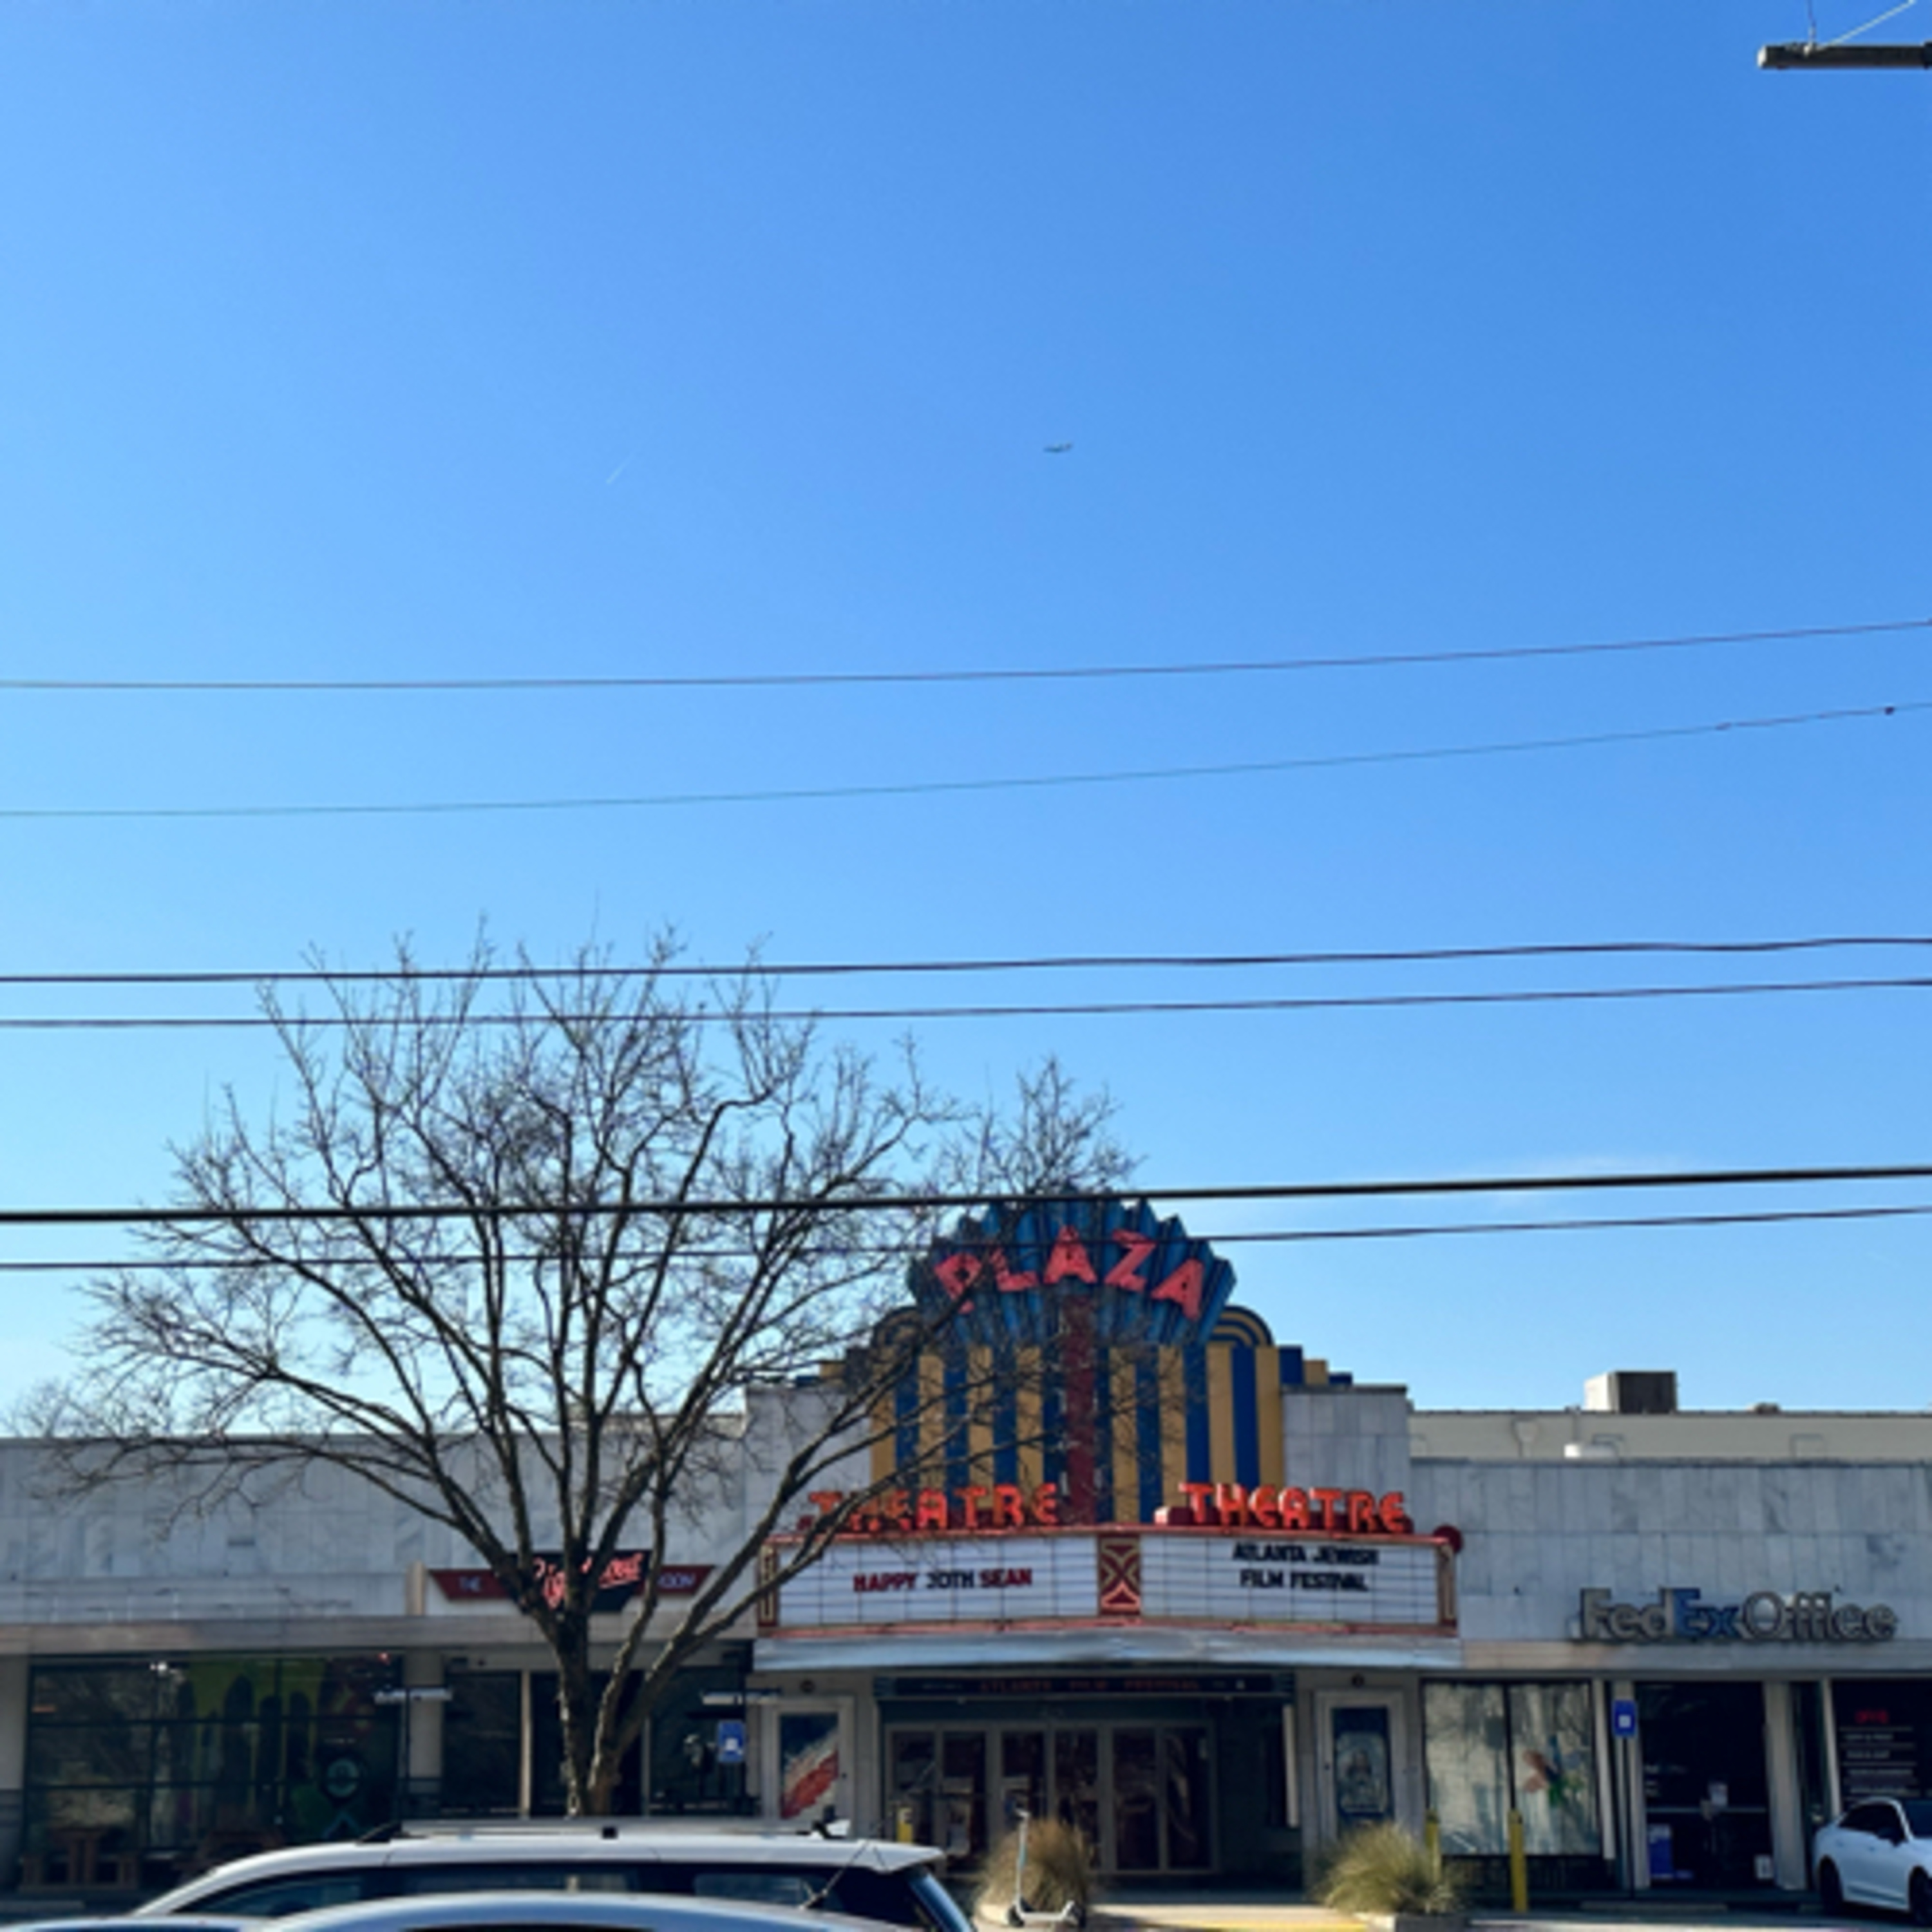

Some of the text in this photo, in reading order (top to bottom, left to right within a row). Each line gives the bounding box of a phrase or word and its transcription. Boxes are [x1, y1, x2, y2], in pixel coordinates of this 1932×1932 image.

[934, 1226, 1204, 1321] PLAZA
[1179, 1482, 1405, 1532] THEATRE
[1233, 1542, 1307, 1561] ATLANTA
[853, 1567, 1033, 1592] HAPPY 30TH SEAN
[1240, 1569, 1370, 1592] FILM FESTIVAL
